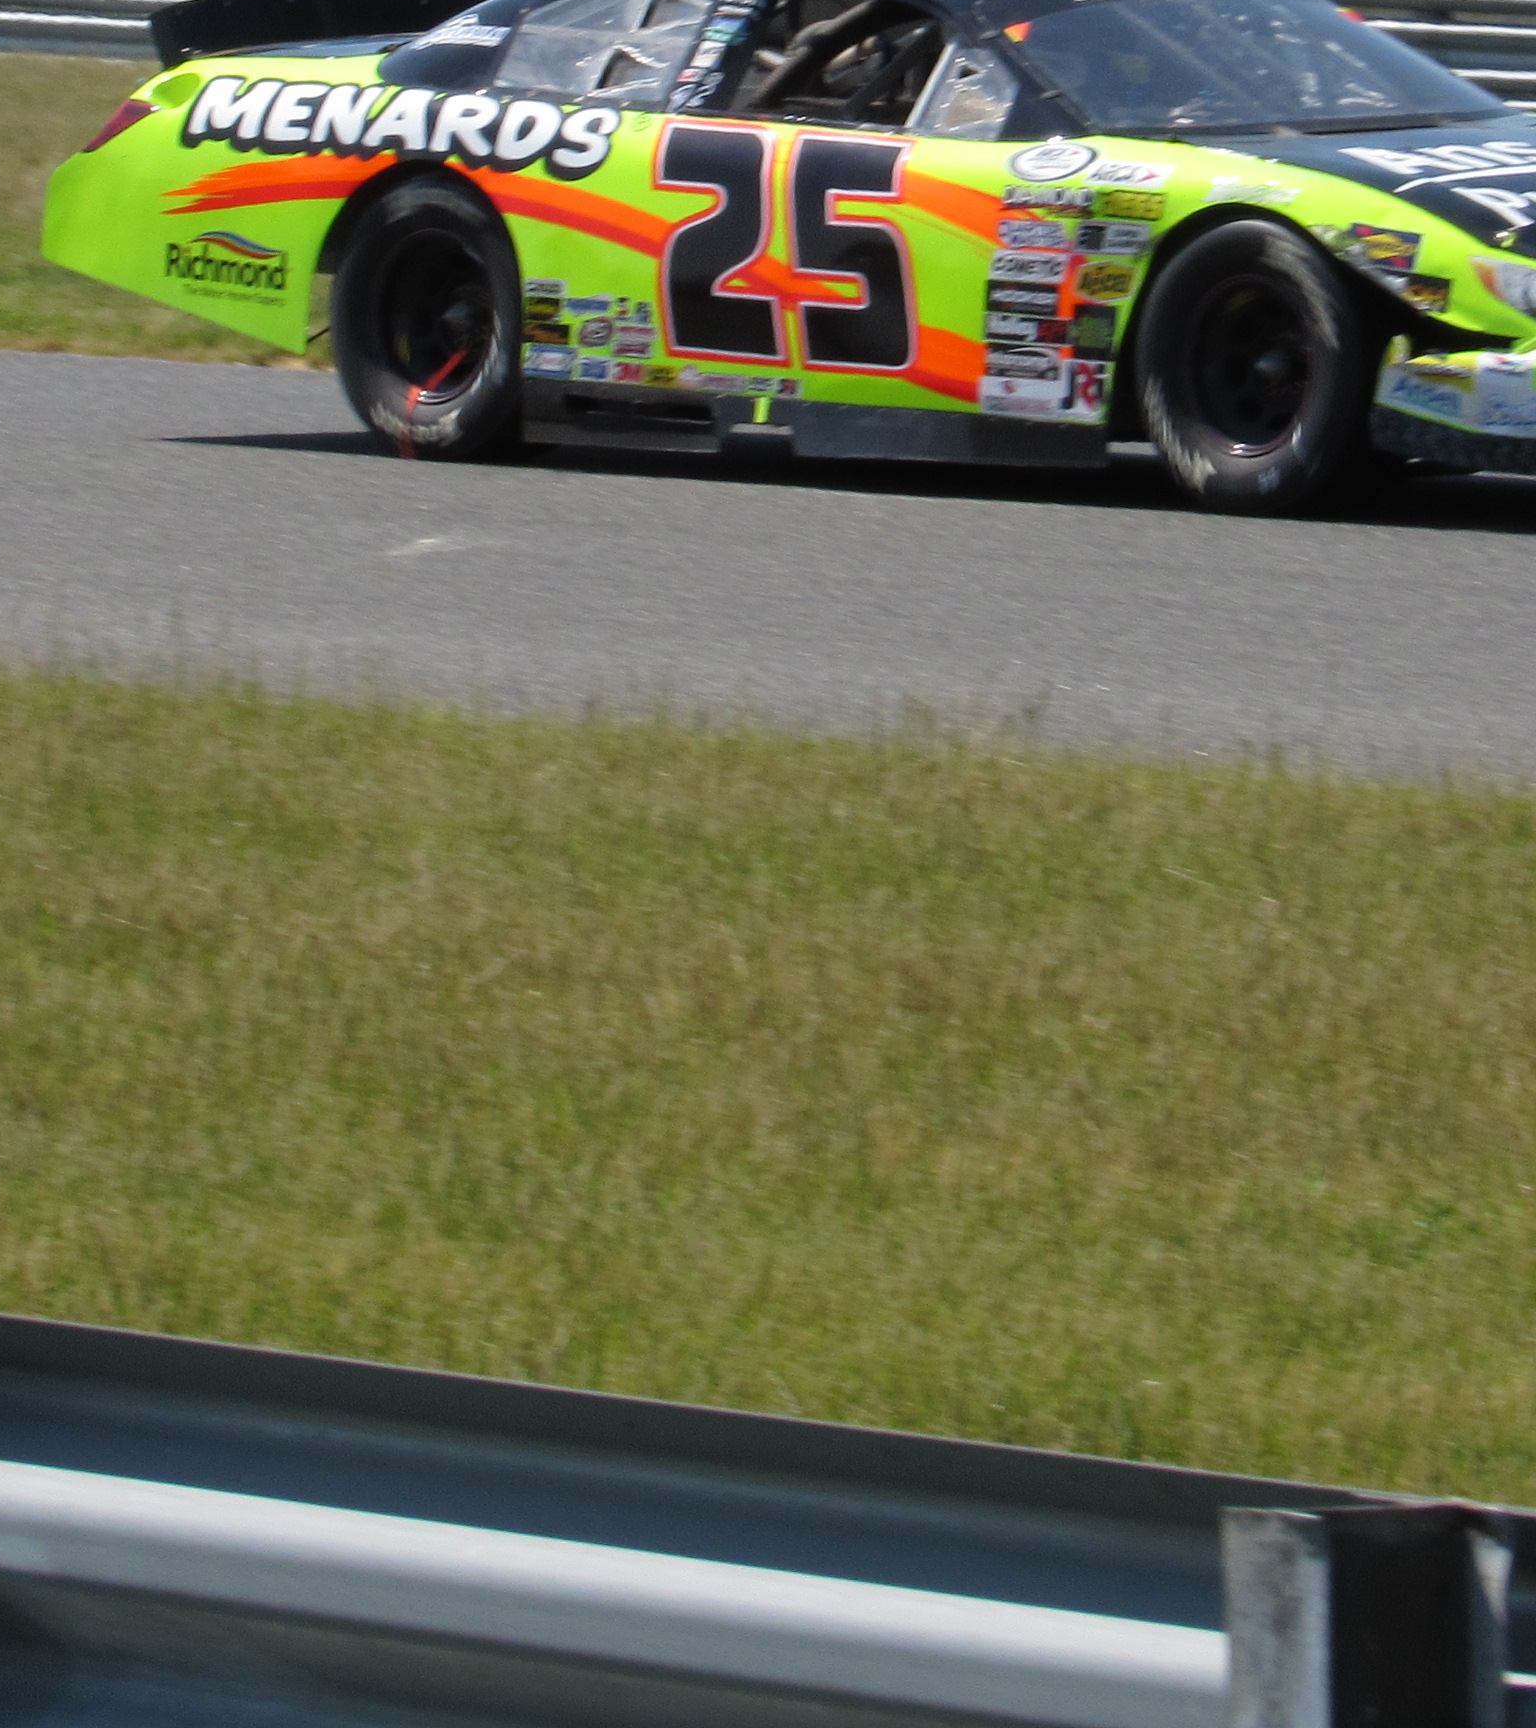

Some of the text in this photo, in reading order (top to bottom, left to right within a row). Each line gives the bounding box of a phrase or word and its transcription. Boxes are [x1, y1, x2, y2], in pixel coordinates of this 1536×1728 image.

[182, 77, 621, 176] MENARDS
[164, 242, 289, 290] Richmond
[654, 117, 918, 374] 25
